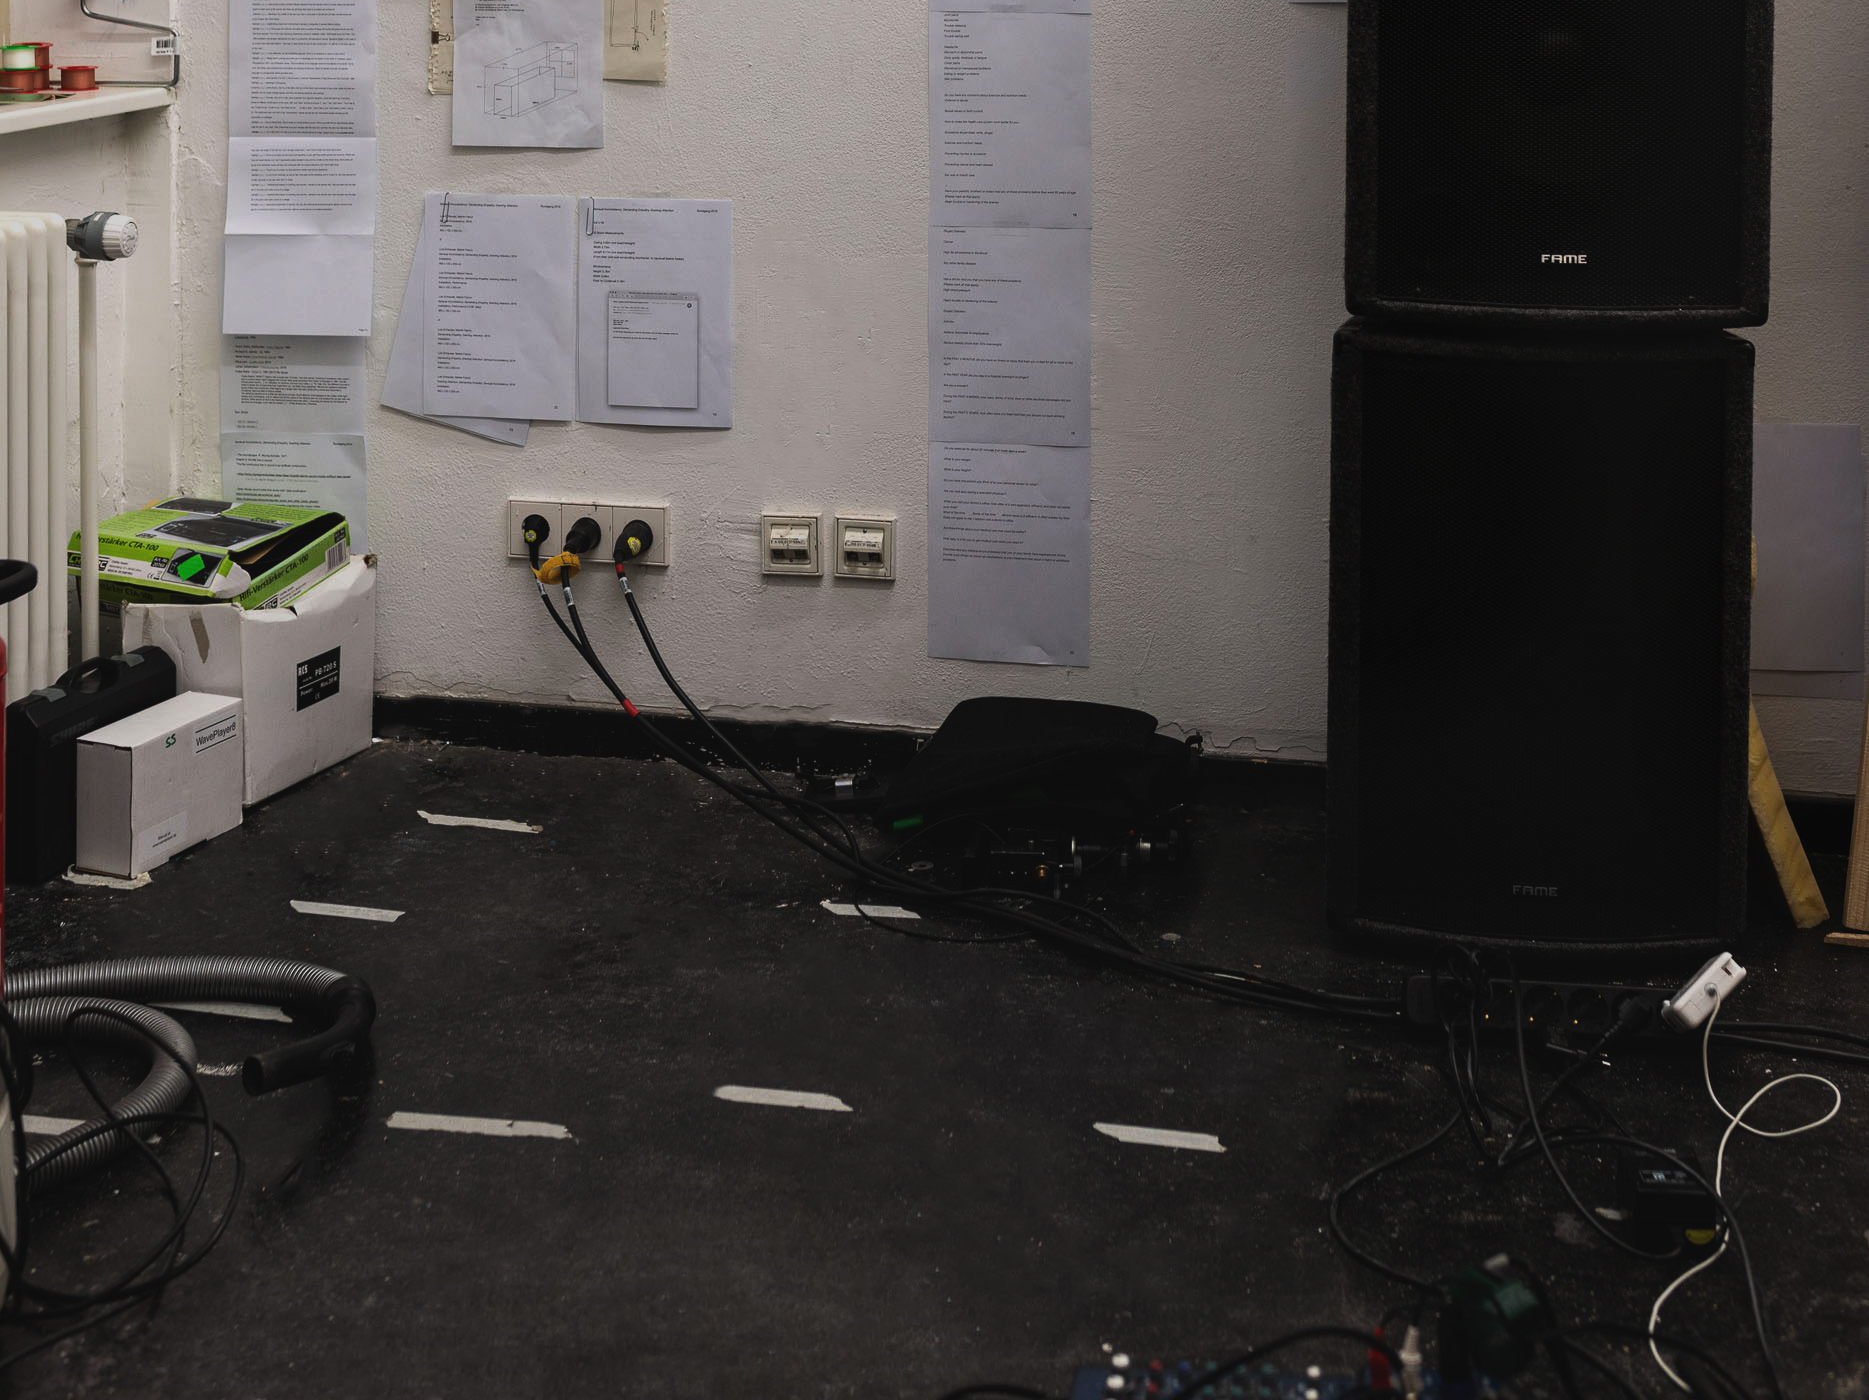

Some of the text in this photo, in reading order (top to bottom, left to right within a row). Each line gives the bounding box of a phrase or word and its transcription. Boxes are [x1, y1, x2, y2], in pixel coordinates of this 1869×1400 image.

[1540, 254, 1588, 265] FAME
[128, 540, 160, 552] CTA-100
[285, 553, 309, 574] CTA-100
[297, 664, 309, 677] RCS
[195, 721, 237, 747] WavePlayer8
[1512, 884, 1559, 897] FAME
